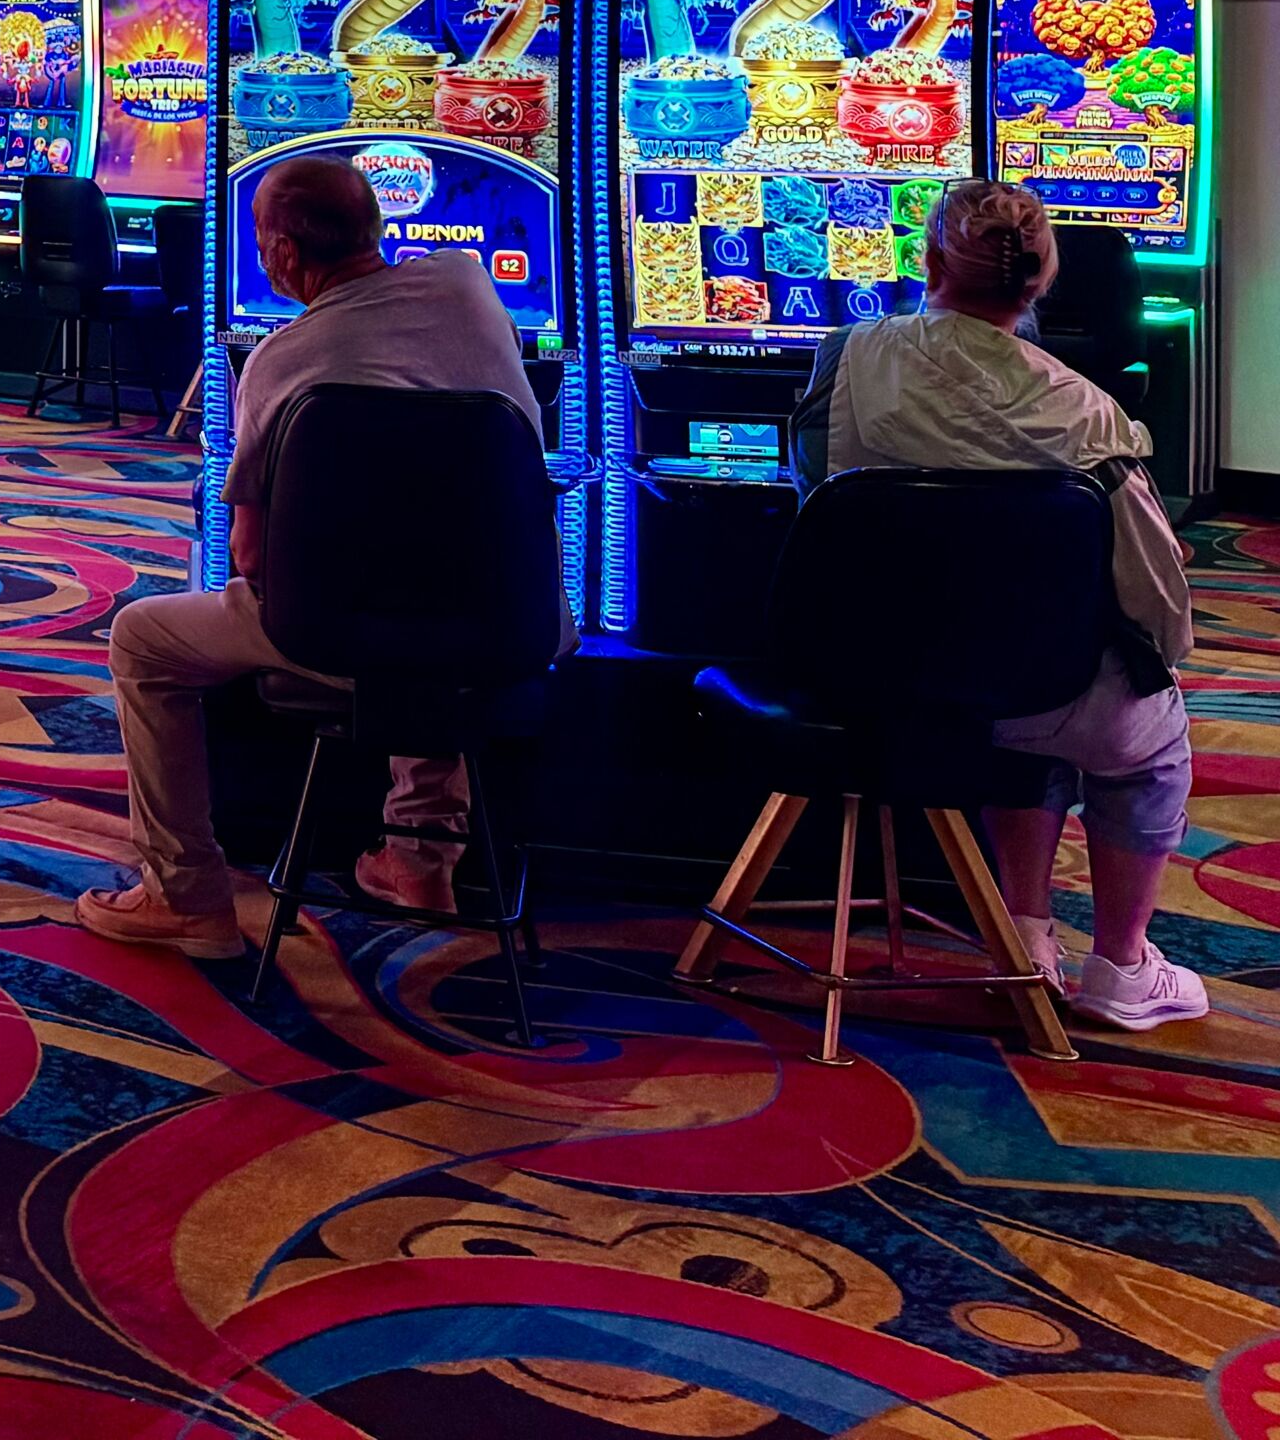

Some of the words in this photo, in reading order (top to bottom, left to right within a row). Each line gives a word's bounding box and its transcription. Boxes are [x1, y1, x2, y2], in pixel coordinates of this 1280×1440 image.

[127, 60, 204, 78] MARIACHI
[112, 78, 207, 101] FORTUNE
[150, 99, 180, 111] TRIO
[1076, 117, 1113, 128] FRENZY
[761, 126, 824, 144] GOLD
[640, 139, 724, 160] WATER
[876, 144, 935, 162] FIRE
[368, 168, 415, 186] Spin
[1032, 165, 1154, 182] DENOMINATION
[655, 181, 677, 216] J
[384, 224, 401, 239] A
[406, 224, 485, 242] DENOM
[713, 234, 750, 267] Q
[500, 260, 519, 272] $2
[783, 287, 821, 318] A
[846, 288, 885, 322] Q
[708, 345, 756, 357] $133.71
